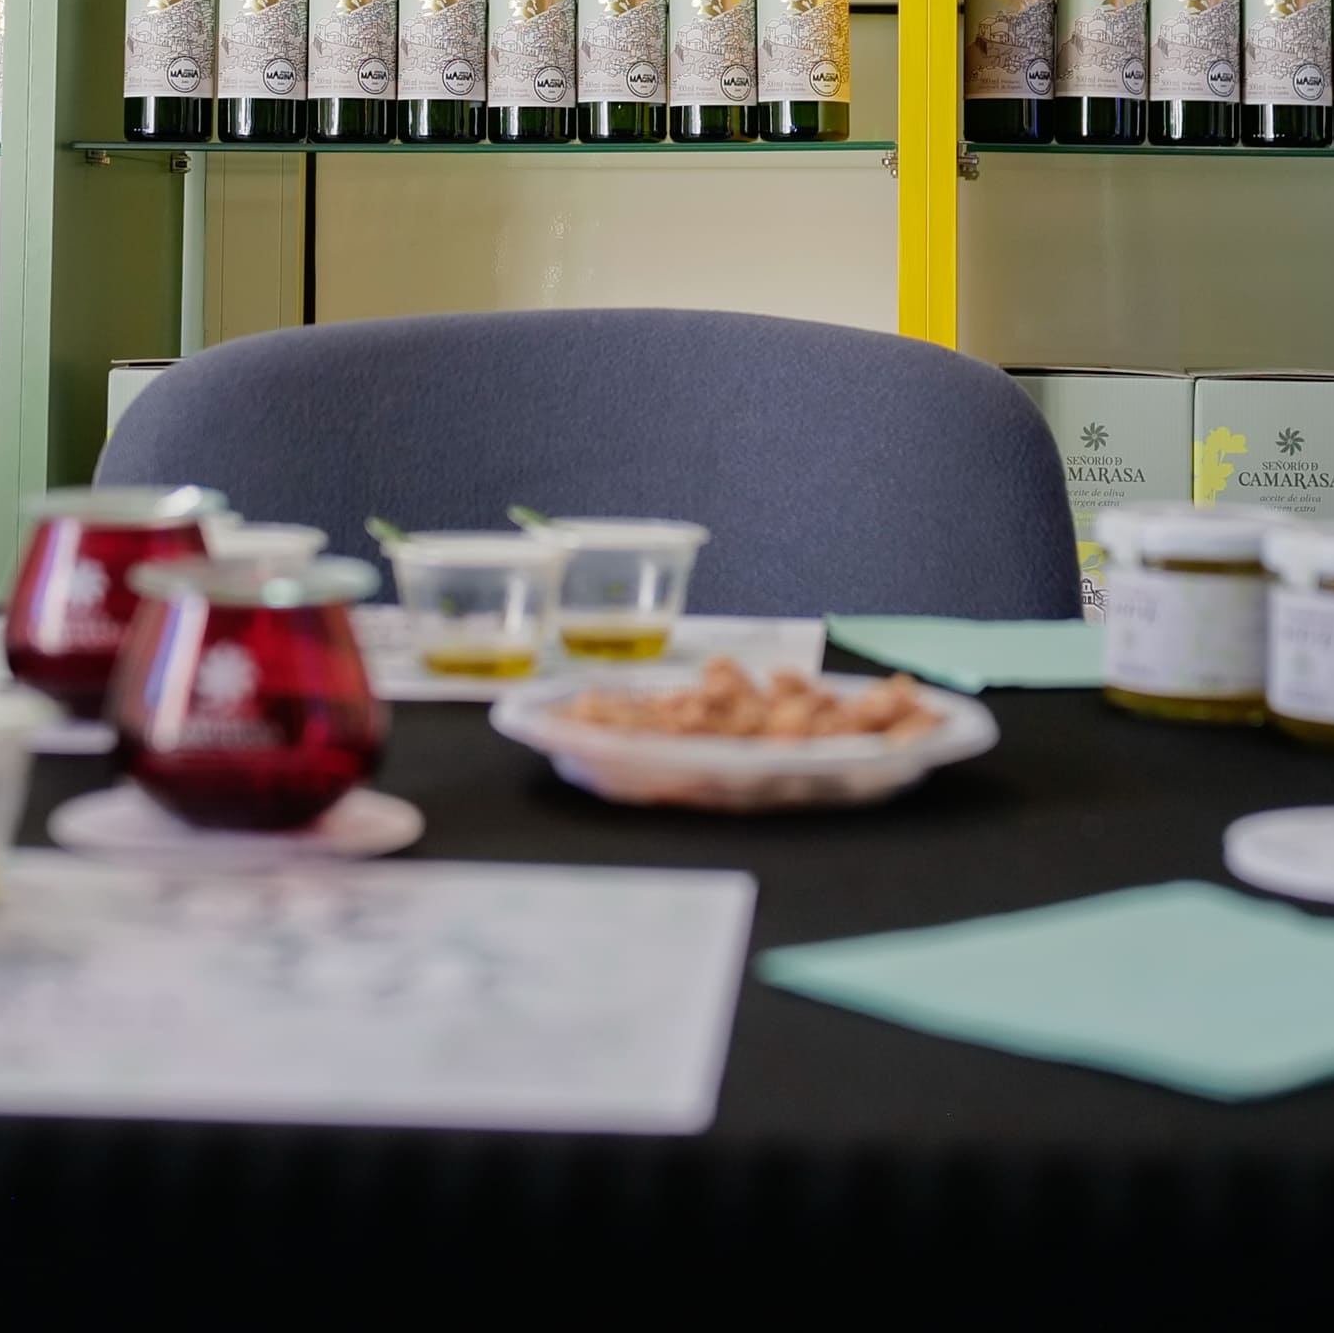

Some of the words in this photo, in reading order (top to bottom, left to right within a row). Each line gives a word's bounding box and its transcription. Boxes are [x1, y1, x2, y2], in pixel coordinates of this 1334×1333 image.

[1067, 468, 1146, 484] MARASA
[1103, 489, 1125, 497] oliva
[1287, 494, 1297, 502] de
[1299, 494, 1321, 502] oliva
